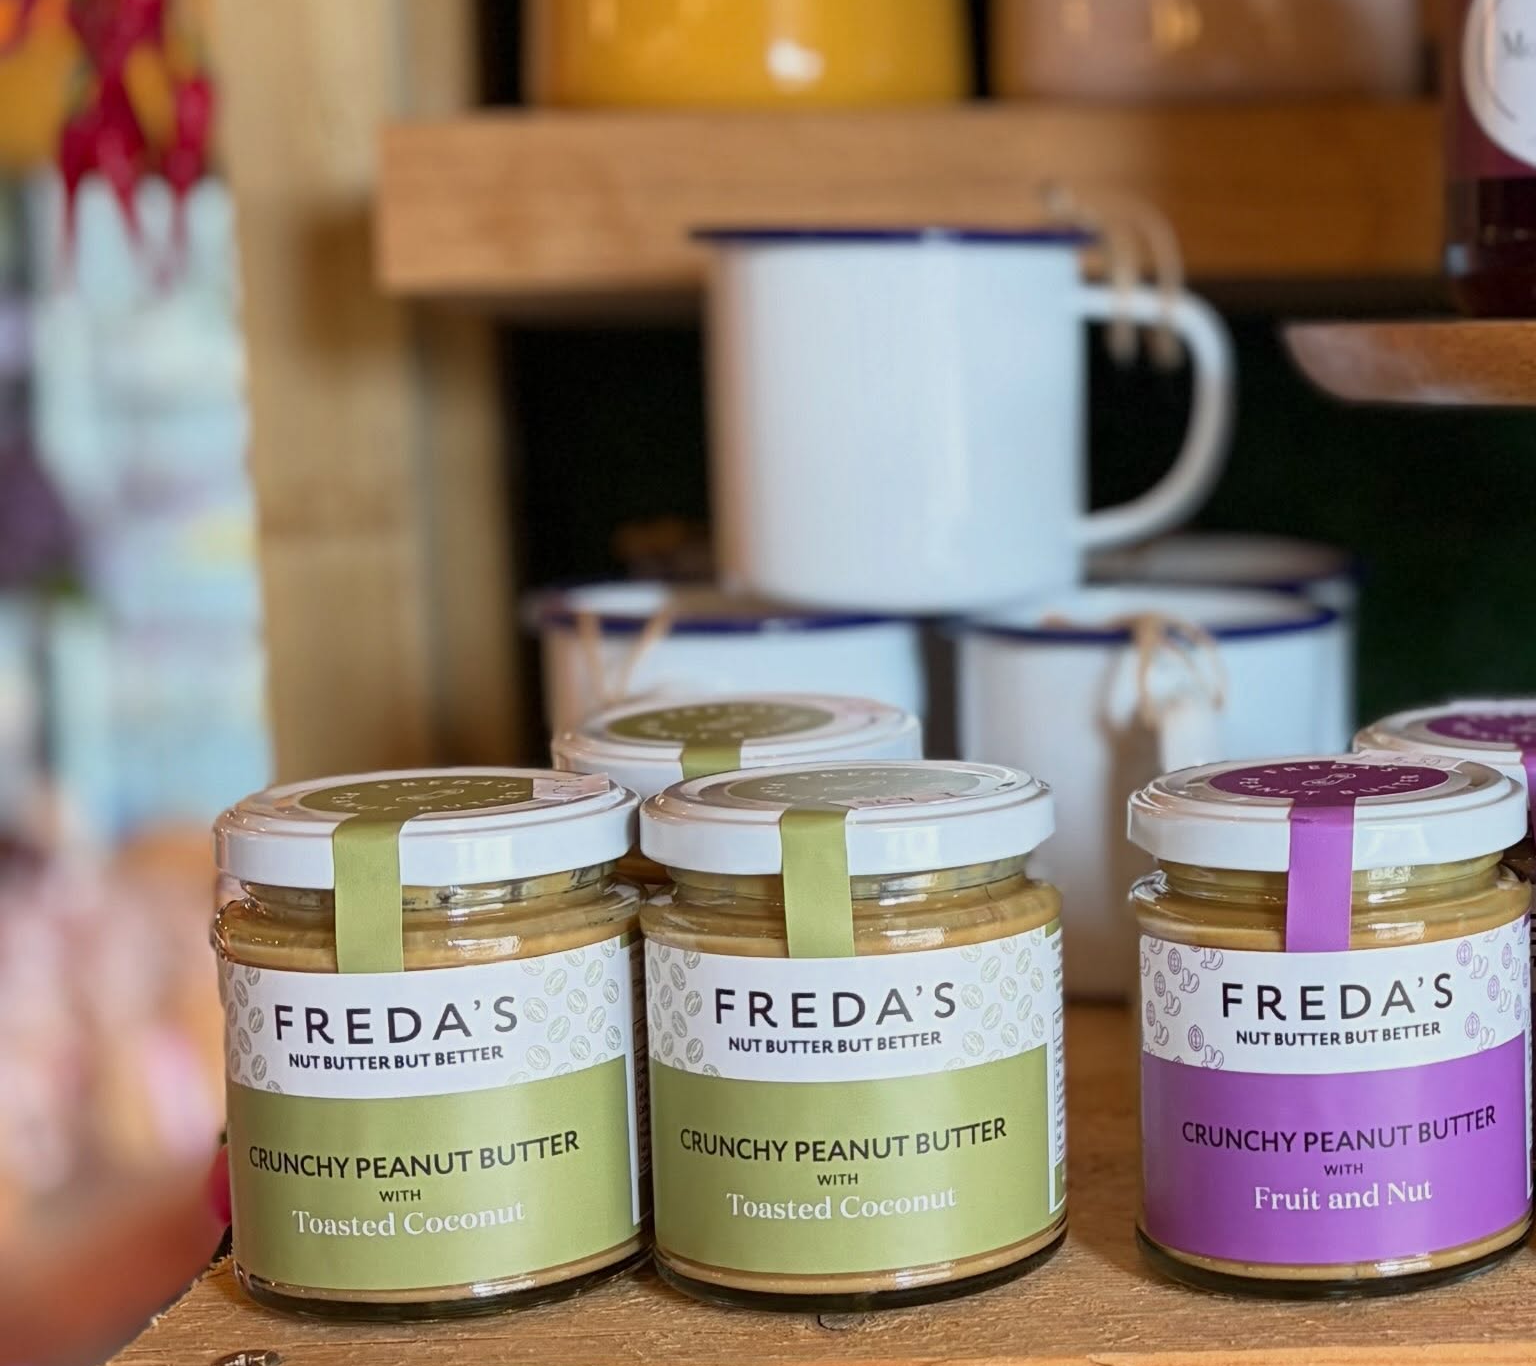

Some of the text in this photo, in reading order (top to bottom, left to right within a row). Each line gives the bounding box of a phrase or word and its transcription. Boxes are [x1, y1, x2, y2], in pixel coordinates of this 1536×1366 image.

[715, 981, 956, 1029] FREDA'S
[1221, 972, 1453, 1022] FREDA'S
[274, 995, 518, 1045] FREDA'S
[1236, 1021, 1441, 1047] NUT BUTTER BUT BETTER
[288, 1045, 504, 1071] NUT BUTTER BUT BETTER
[728, 1030, 942, 1055] NUT BUTTER BUT BETTER
[680, 1117, 1007, 1163] CRUNCHY PEANUT BUTTER
[1182, 1105, 1496, 1153] CRUNCHY PEANUT BUTTER
[249, 1130, 580, 1180] CRUNCHY PEANUT BUTTER
[1323, 1163, 1364, 1176] WITH
[379, 1188, 421, 1203] WITH
[817, 1173, 859, 1186] WITH
[1254, 1180, 1433, 1211] Fruit and Nut
[292, 1201, 526, 1237] Toasted Coconut
[726, 1187, 956, 1220] Toasted Coconut
